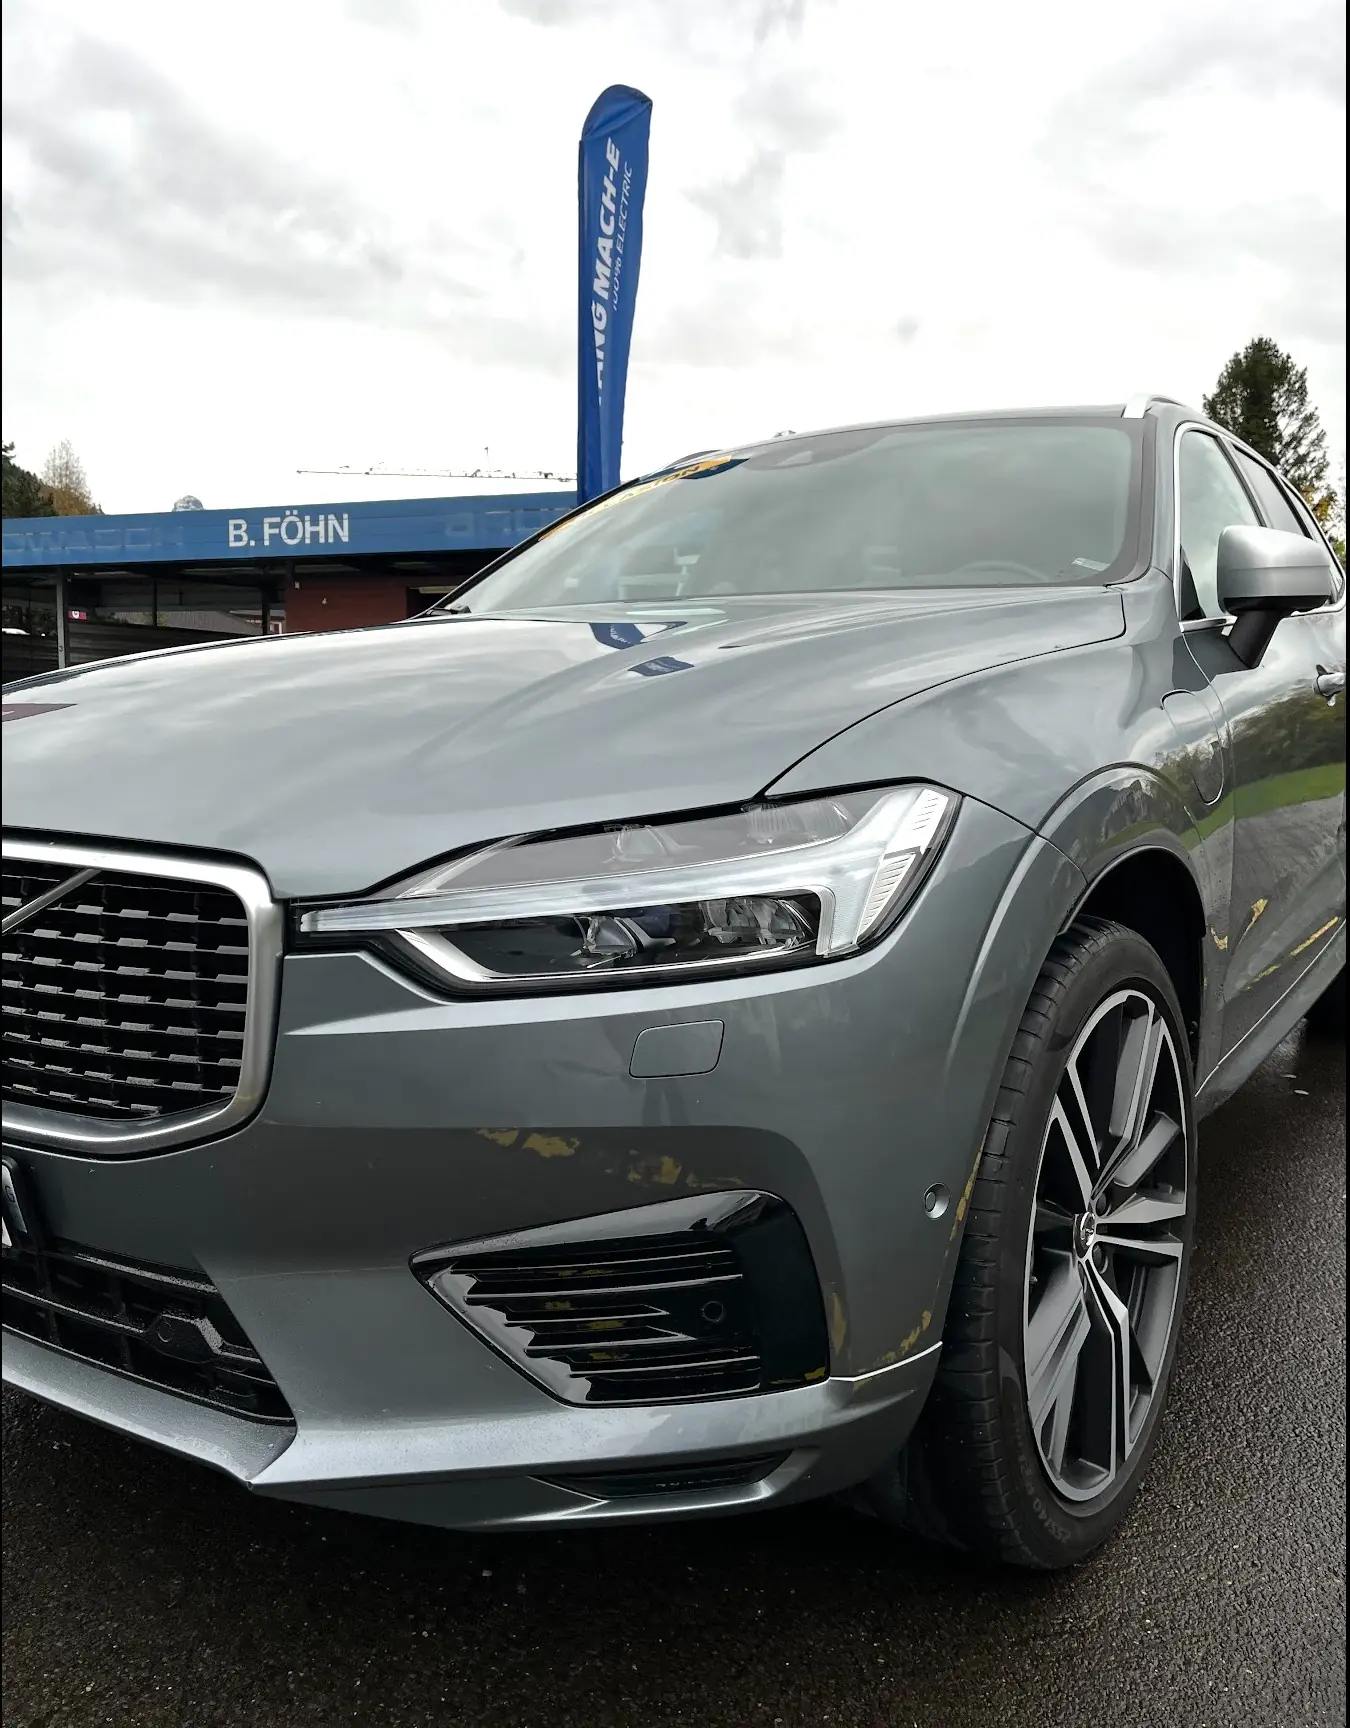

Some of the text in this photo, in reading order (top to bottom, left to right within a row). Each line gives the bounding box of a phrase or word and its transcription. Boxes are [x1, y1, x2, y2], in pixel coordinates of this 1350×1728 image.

[593, 137, 620, 300] MACH-E
[616, 161, 633, 254] ELECTRIC
[228, 509, 349, 547] B. FÖHN
